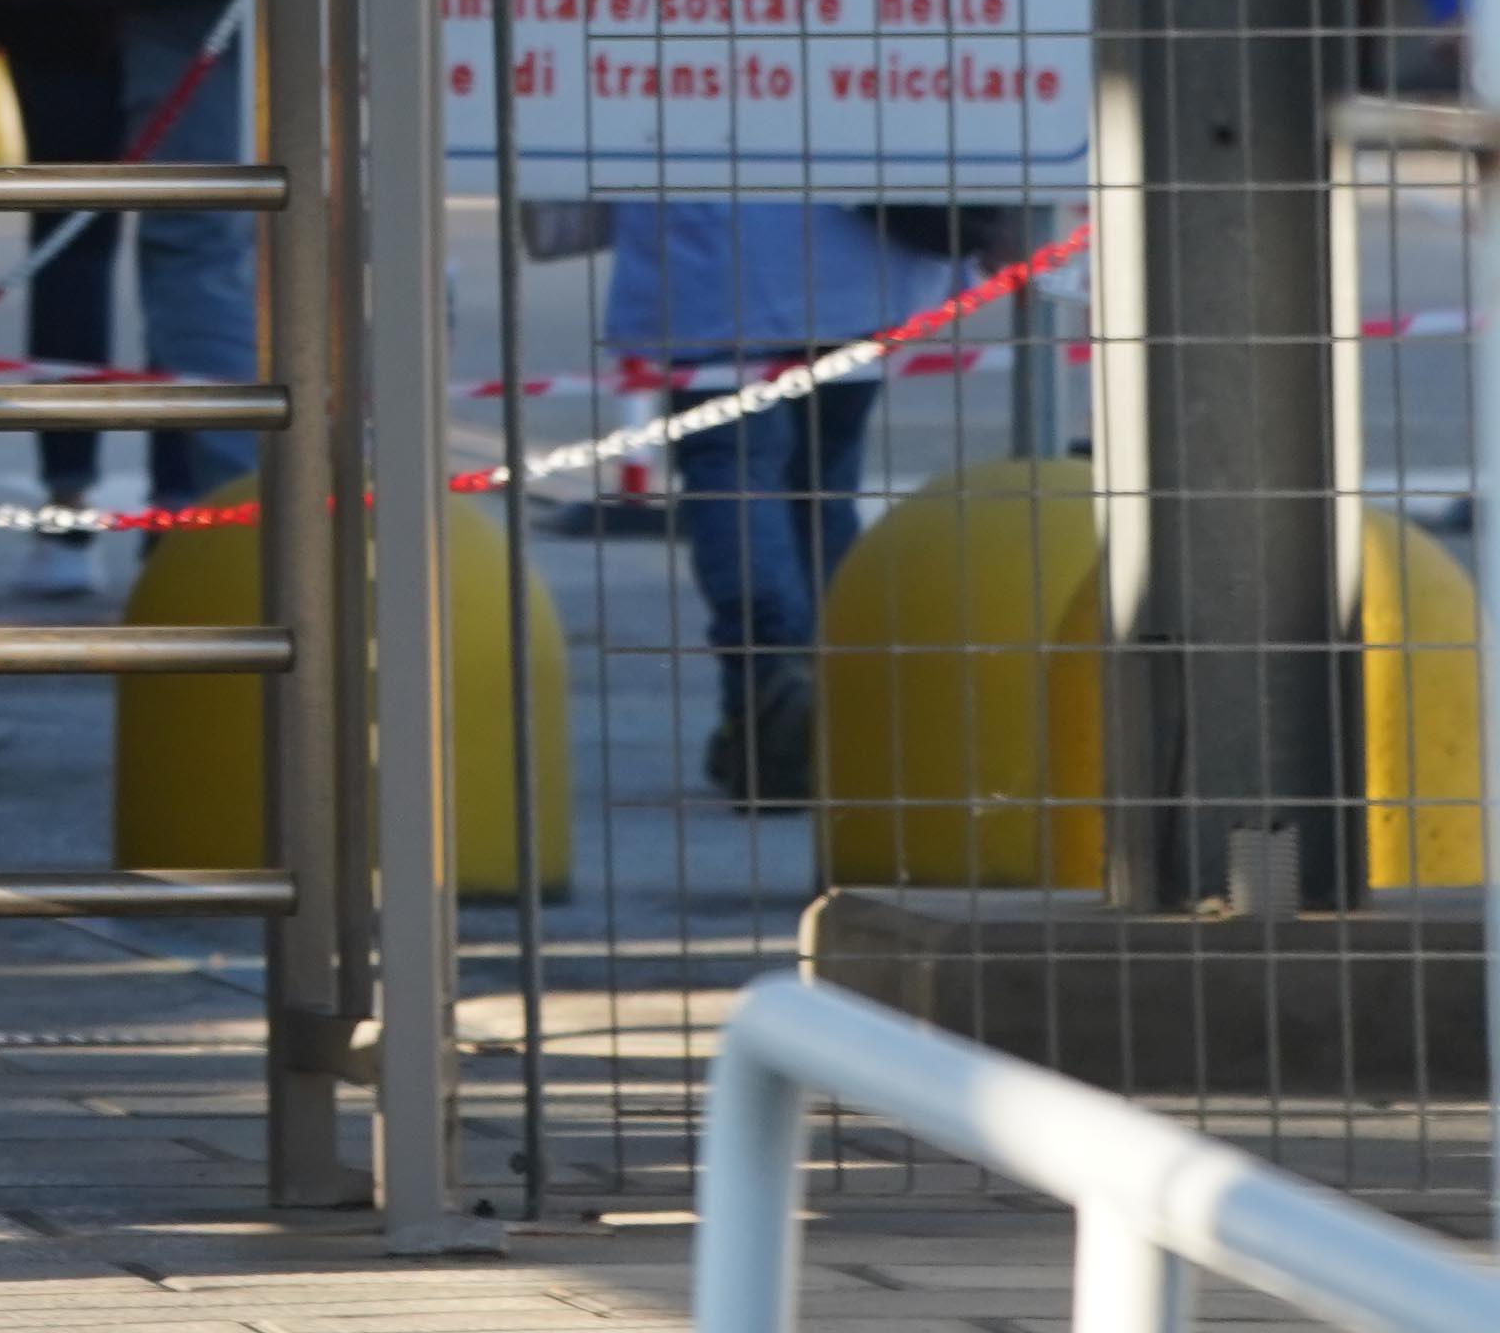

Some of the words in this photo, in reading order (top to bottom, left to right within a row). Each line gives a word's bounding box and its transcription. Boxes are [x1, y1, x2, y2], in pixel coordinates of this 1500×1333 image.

[513, 50, 555, 97] di
[593, 49, 793, 99] transito
[829, 53, 1060, 101] veicolare
